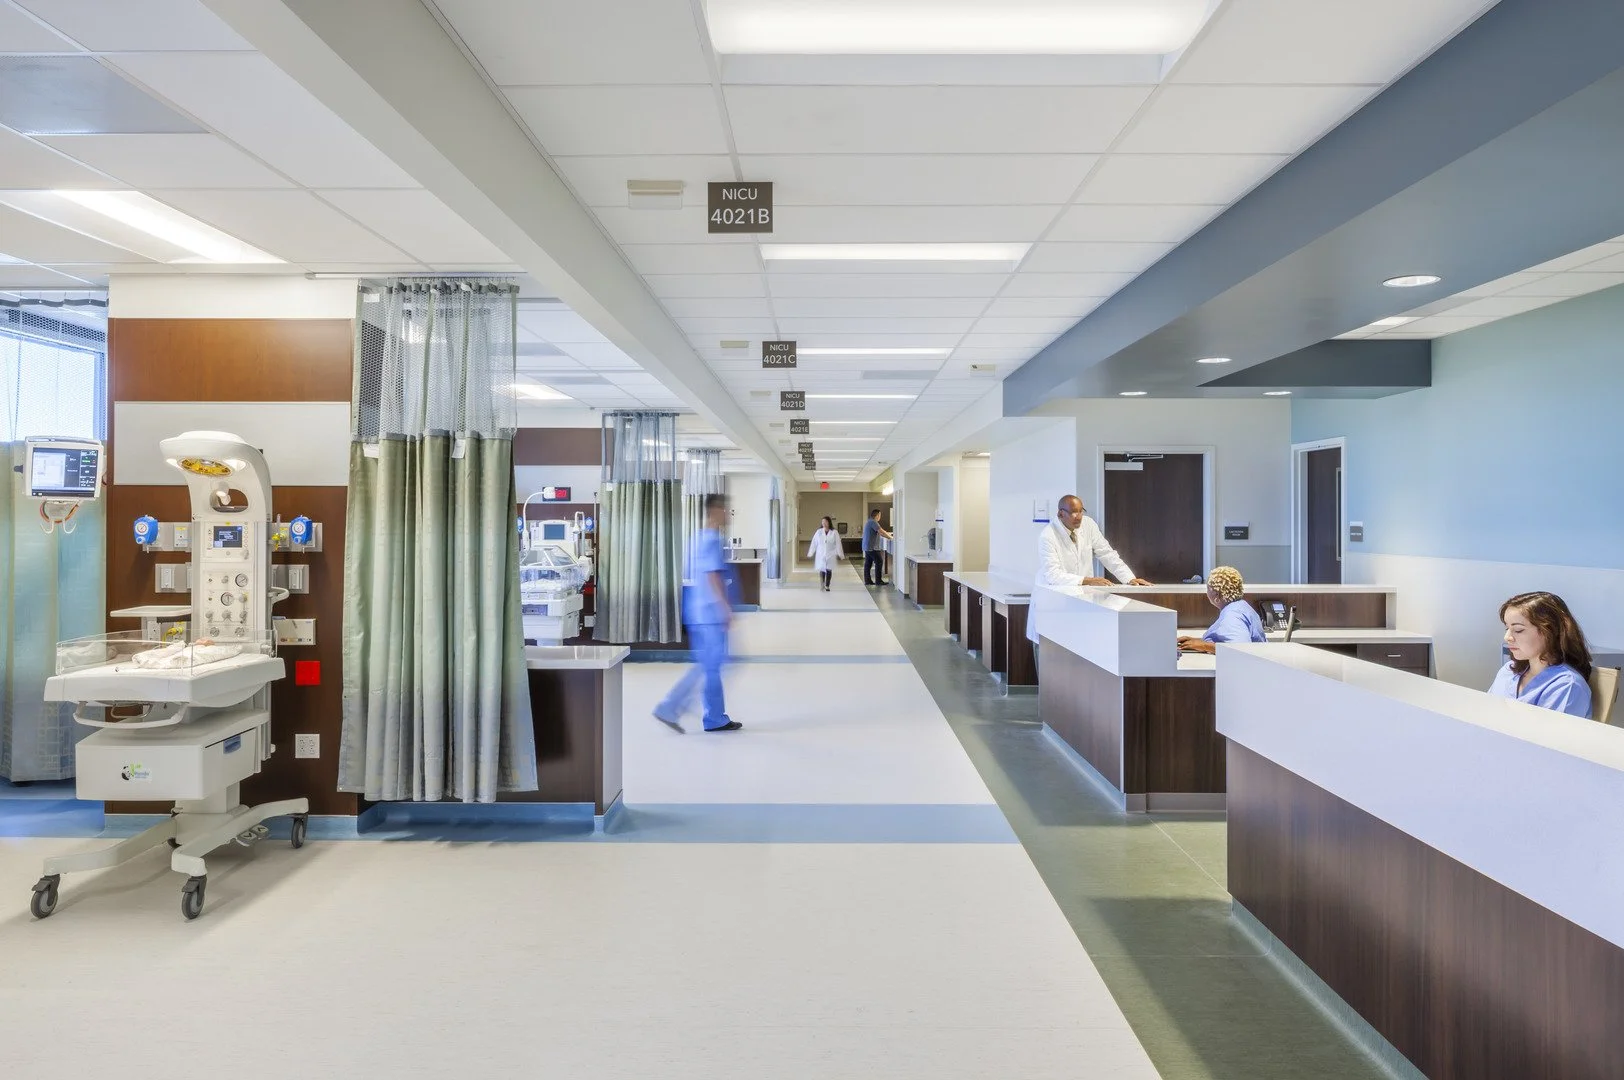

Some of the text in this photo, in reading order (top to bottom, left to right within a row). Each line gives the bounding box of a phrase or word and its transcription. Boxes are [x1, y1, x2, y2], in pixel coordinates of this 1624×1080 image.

[722, 188, 758, 200] NICU
[710, 208, 770, 225] 4021B
[763, 354, 796, 364] 4021C
[781, 400, 805, 408] 4021D
